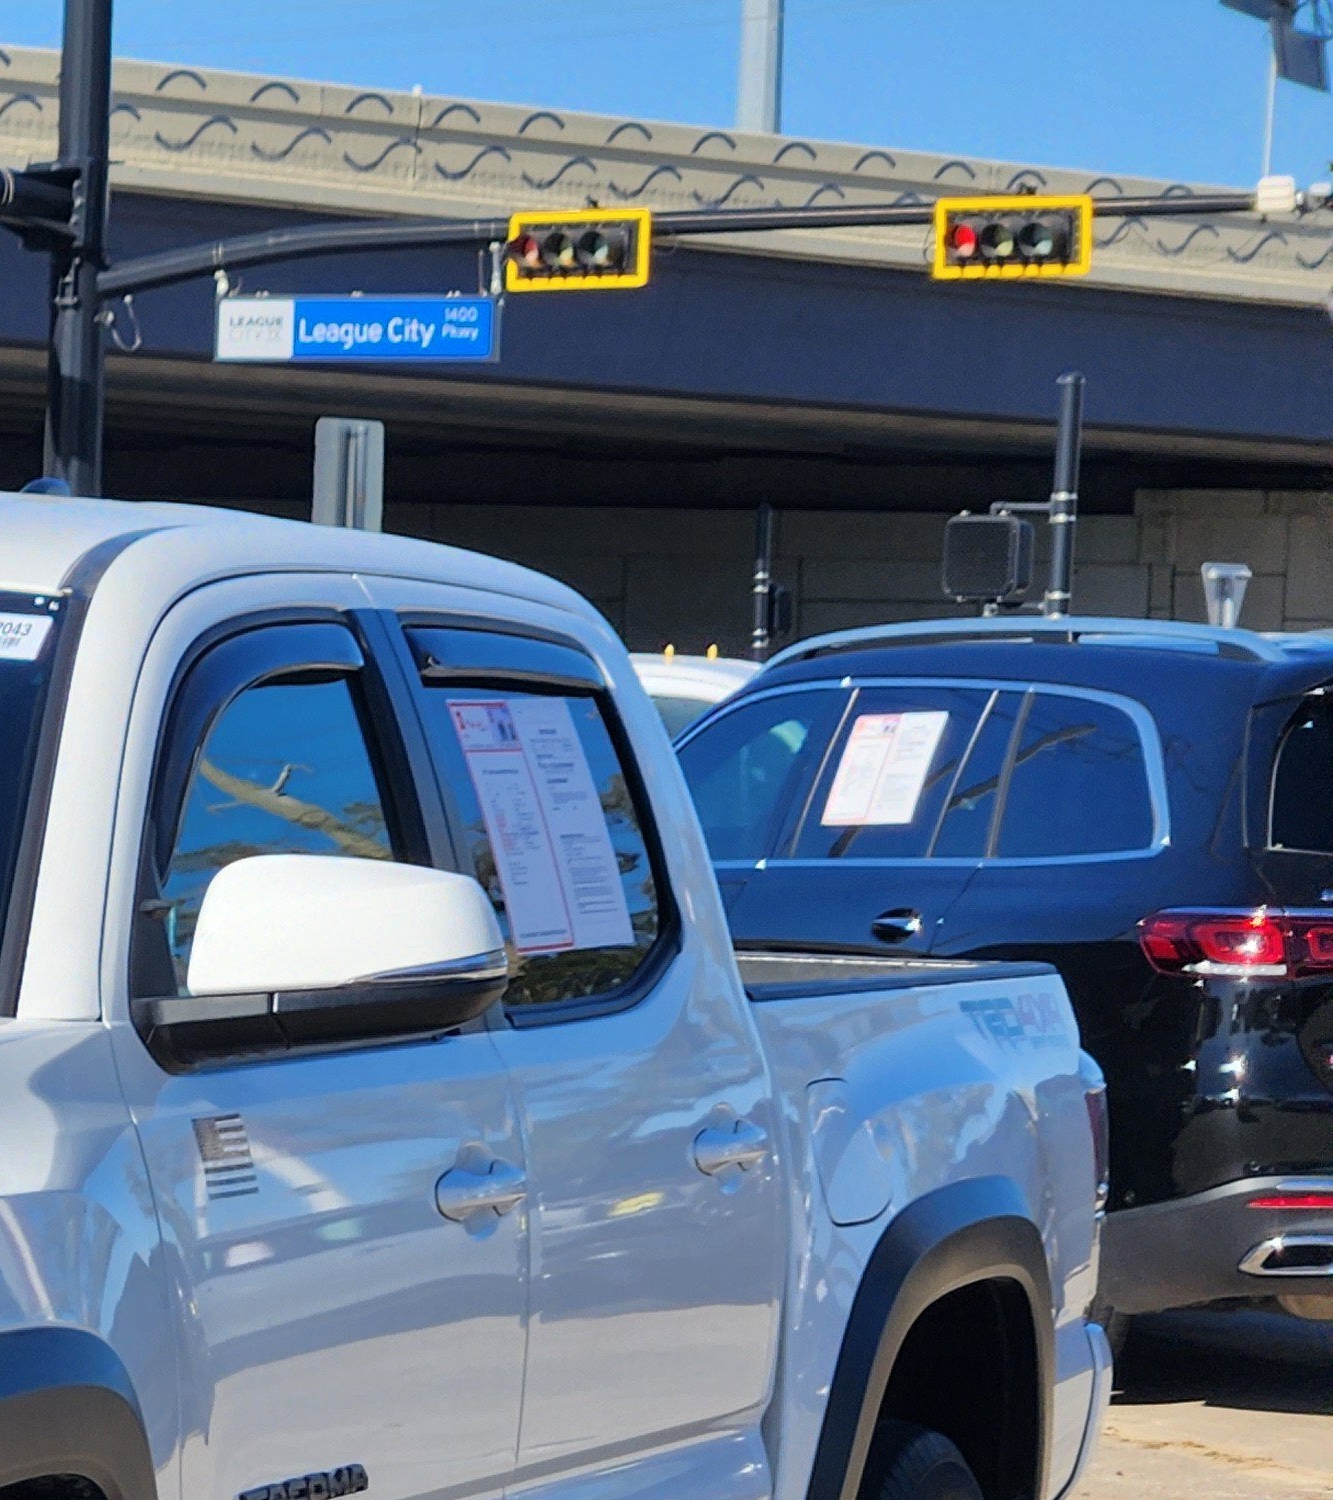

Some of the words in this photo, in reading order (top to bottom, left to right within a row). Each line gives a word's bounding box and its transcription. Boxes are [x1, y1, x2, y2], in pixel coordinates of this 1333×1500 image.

[229, 315, 284, 327] LEAGUE
[444, 306, 478, 322] 1400
[298, 317, 383, 350] League
[387, 316, 436, 348] City
